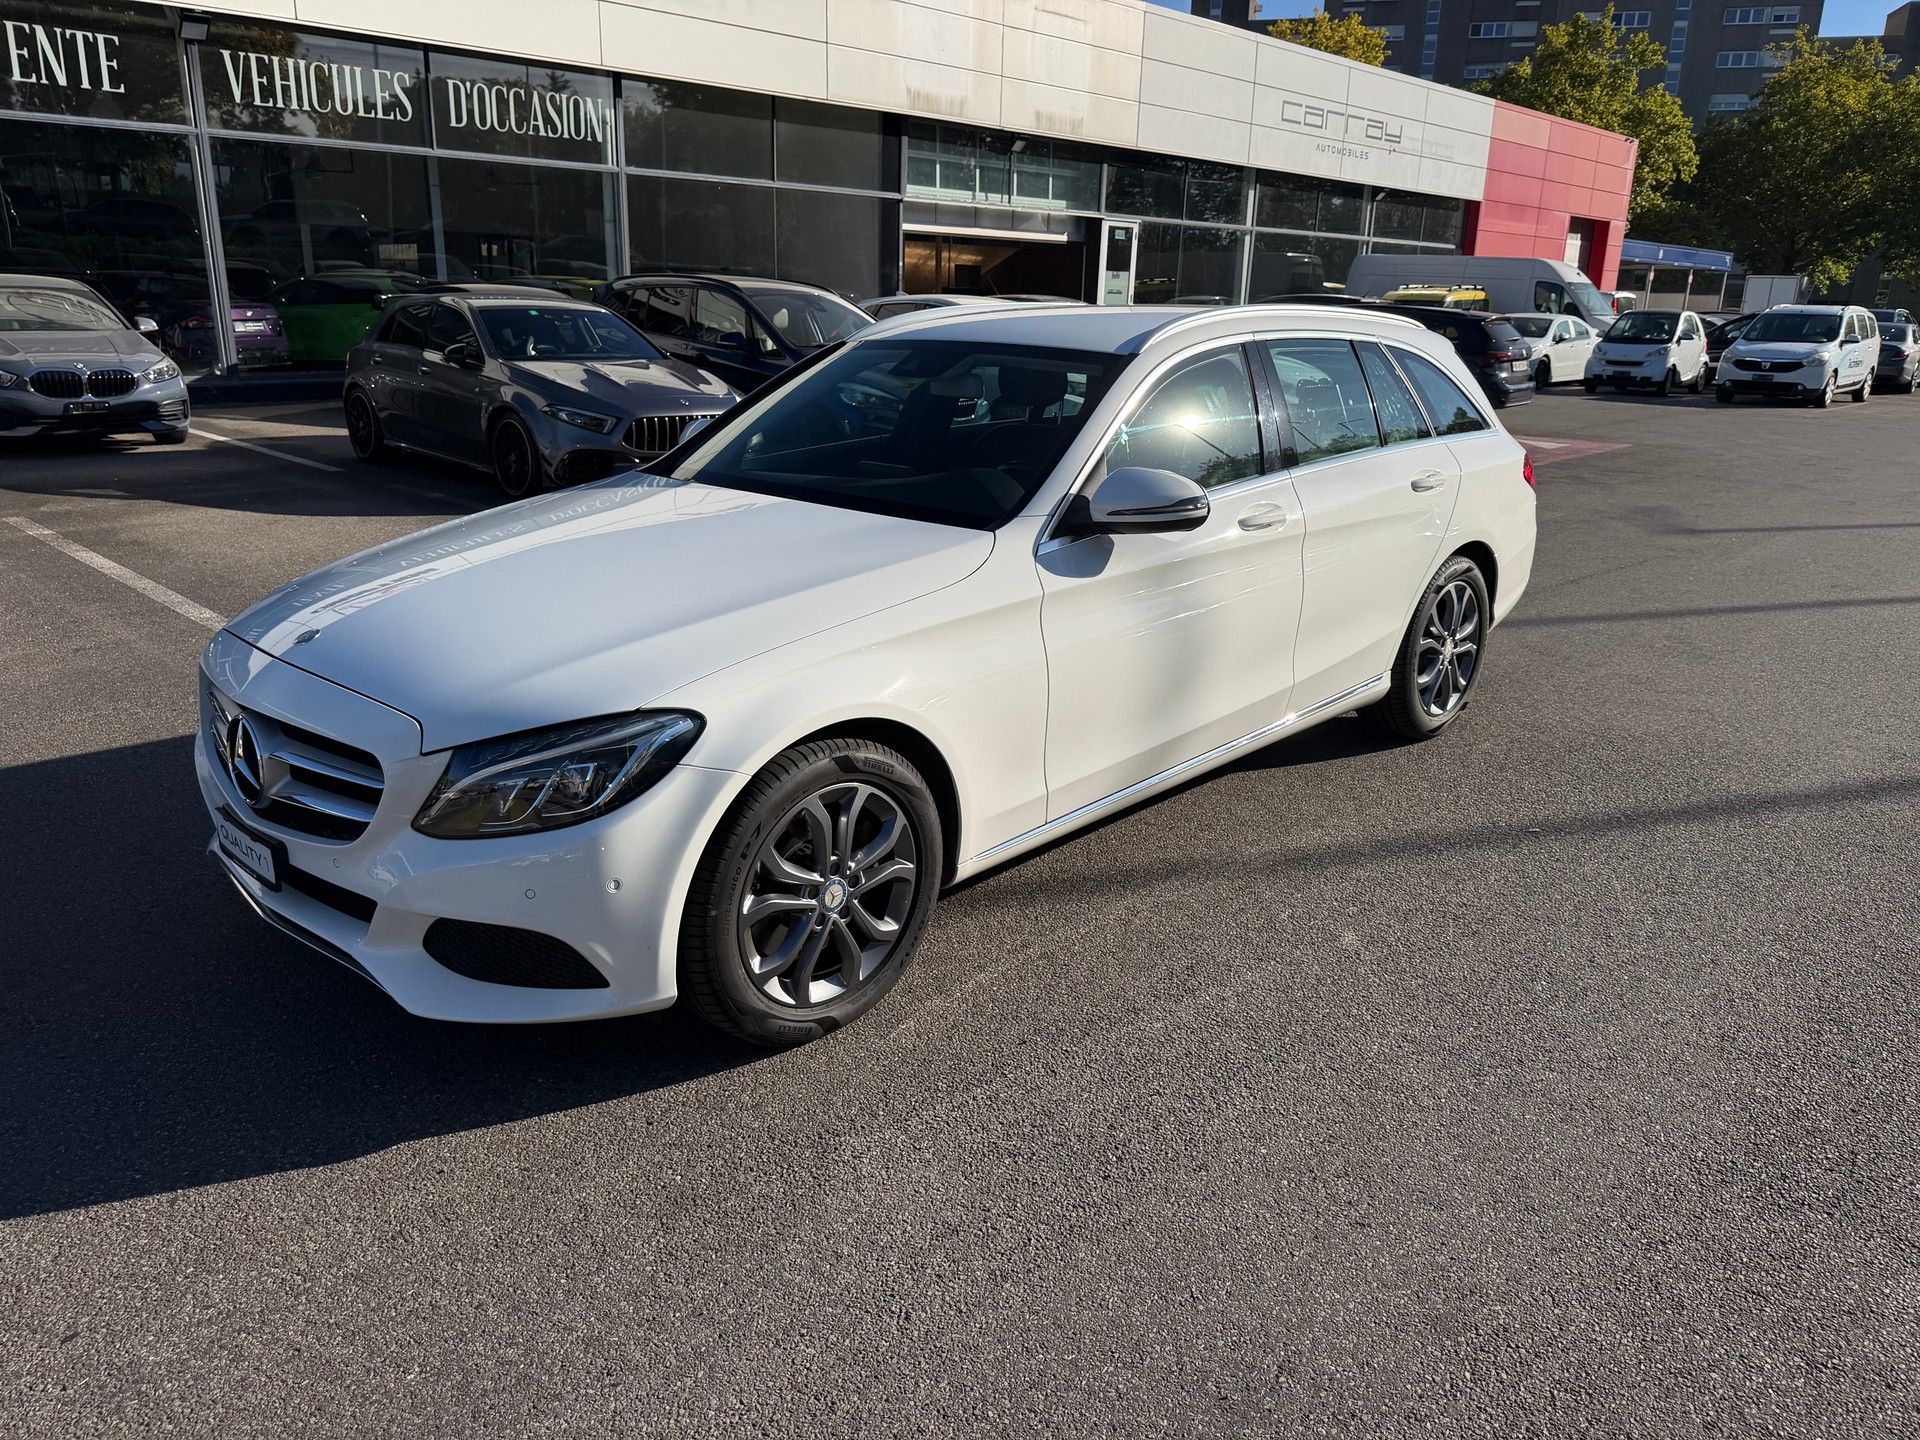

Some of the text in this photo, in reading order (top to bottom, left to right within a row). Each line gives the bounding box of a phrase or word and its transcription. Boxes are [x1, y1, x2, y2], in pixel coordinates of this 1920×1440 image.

[1, 20, 604, 143] ENTE VEHICULES D'OCCASION
[1281, 99, 1403, 145] carray
[1315, 143, 1370, 160] AUTOMOBILES
[862, 756, 895, 775] PIRELLI
